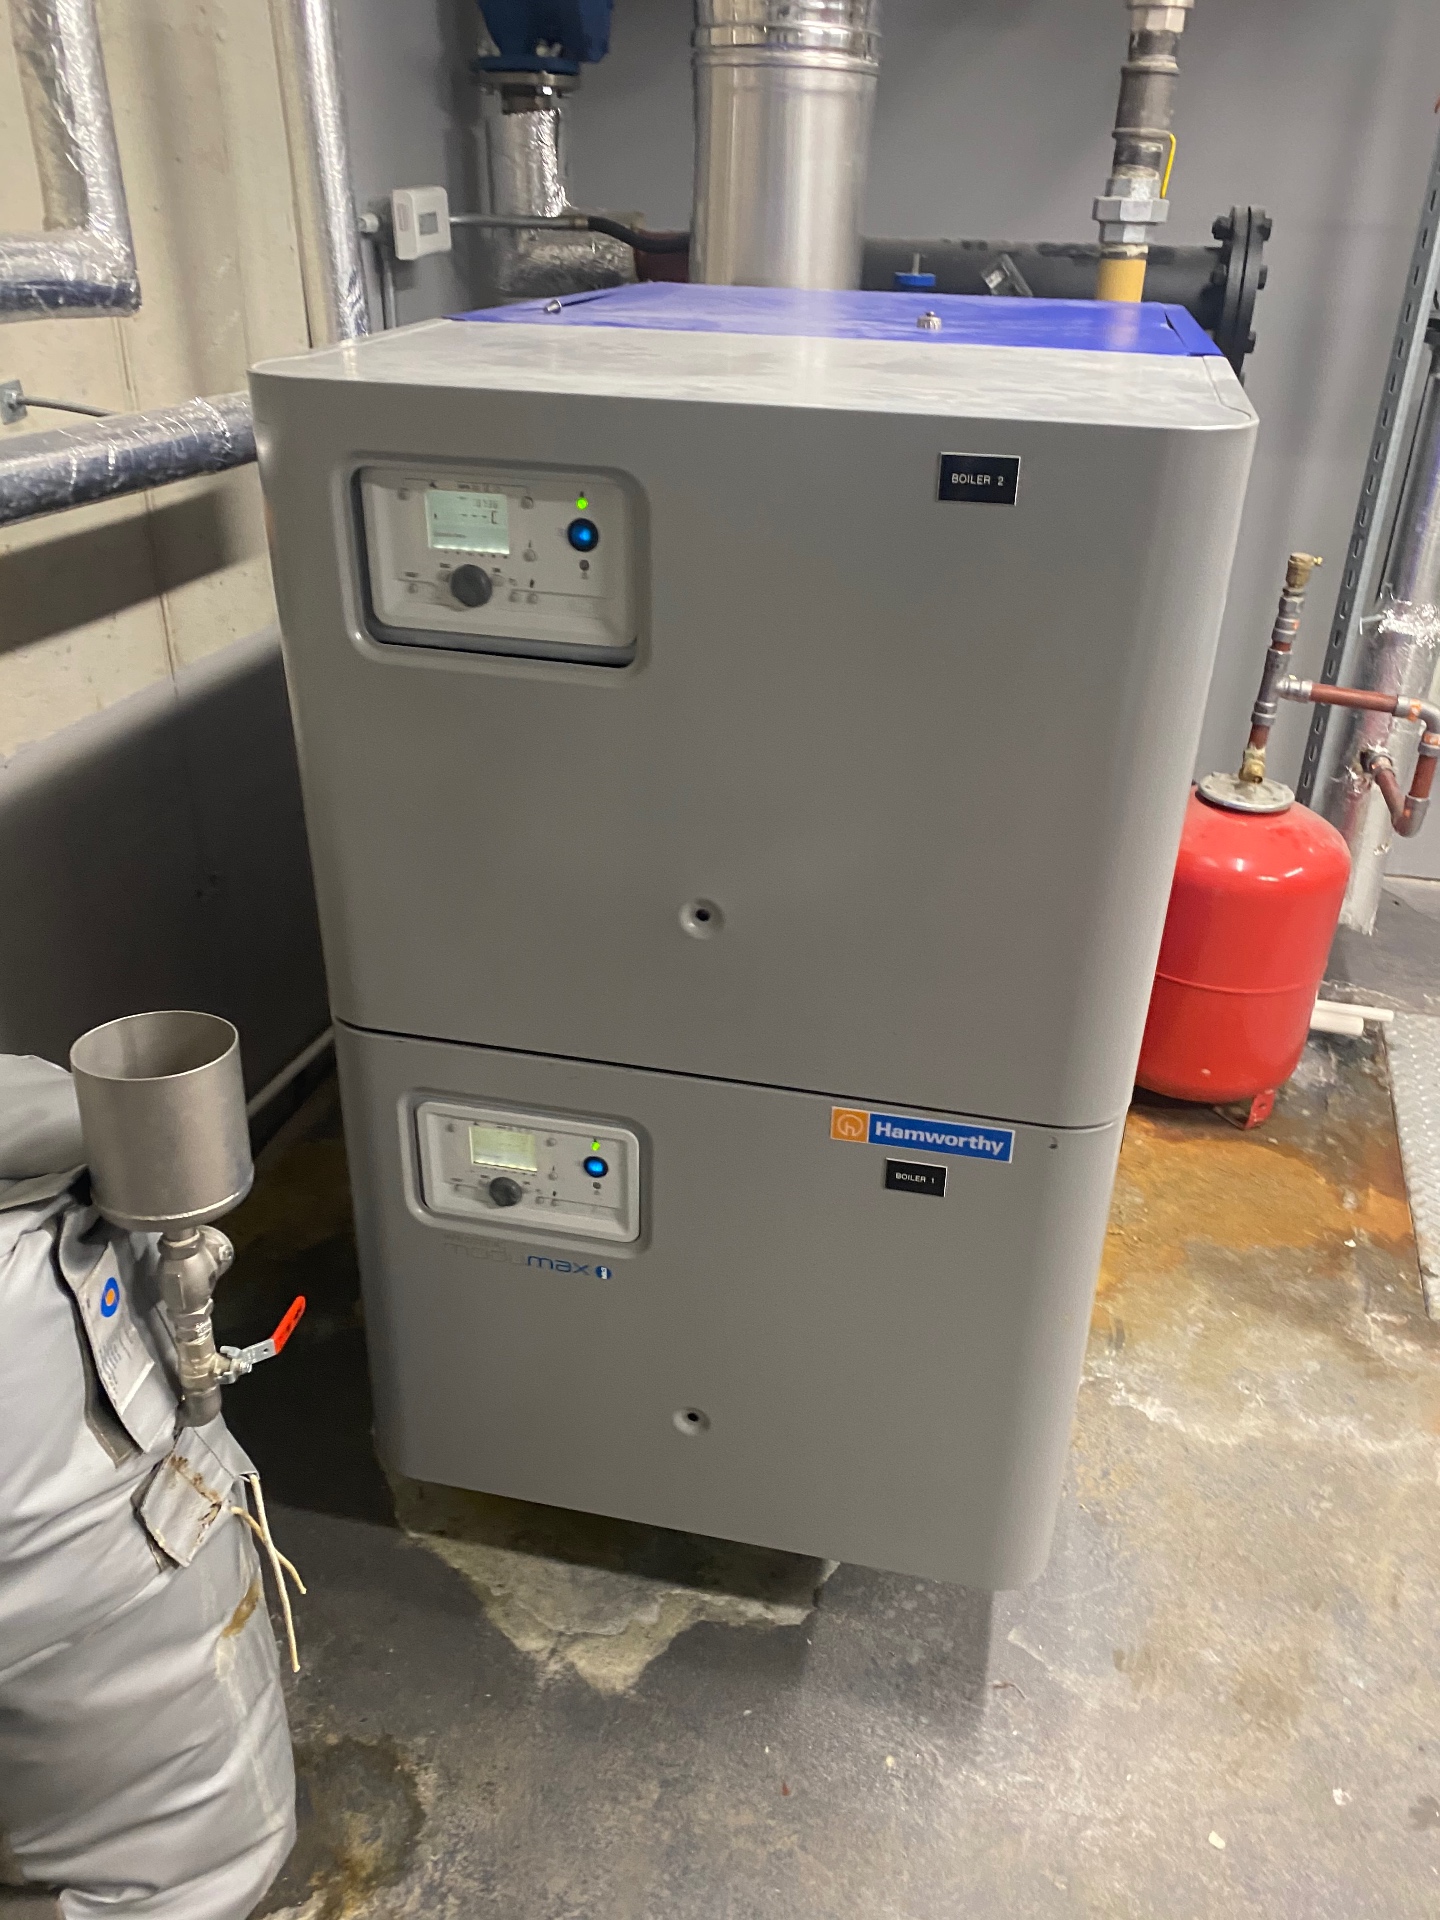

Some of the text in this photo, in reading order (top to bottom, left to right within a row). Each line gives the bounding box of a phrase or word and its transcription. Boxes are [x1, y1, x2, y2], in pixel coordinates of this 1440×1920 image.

[951, 472, 1004, 487] BOILER 2
[874, 1120, 1004, 1156] Hamworthy
[895, 1172, 926, 1183] BOILER
